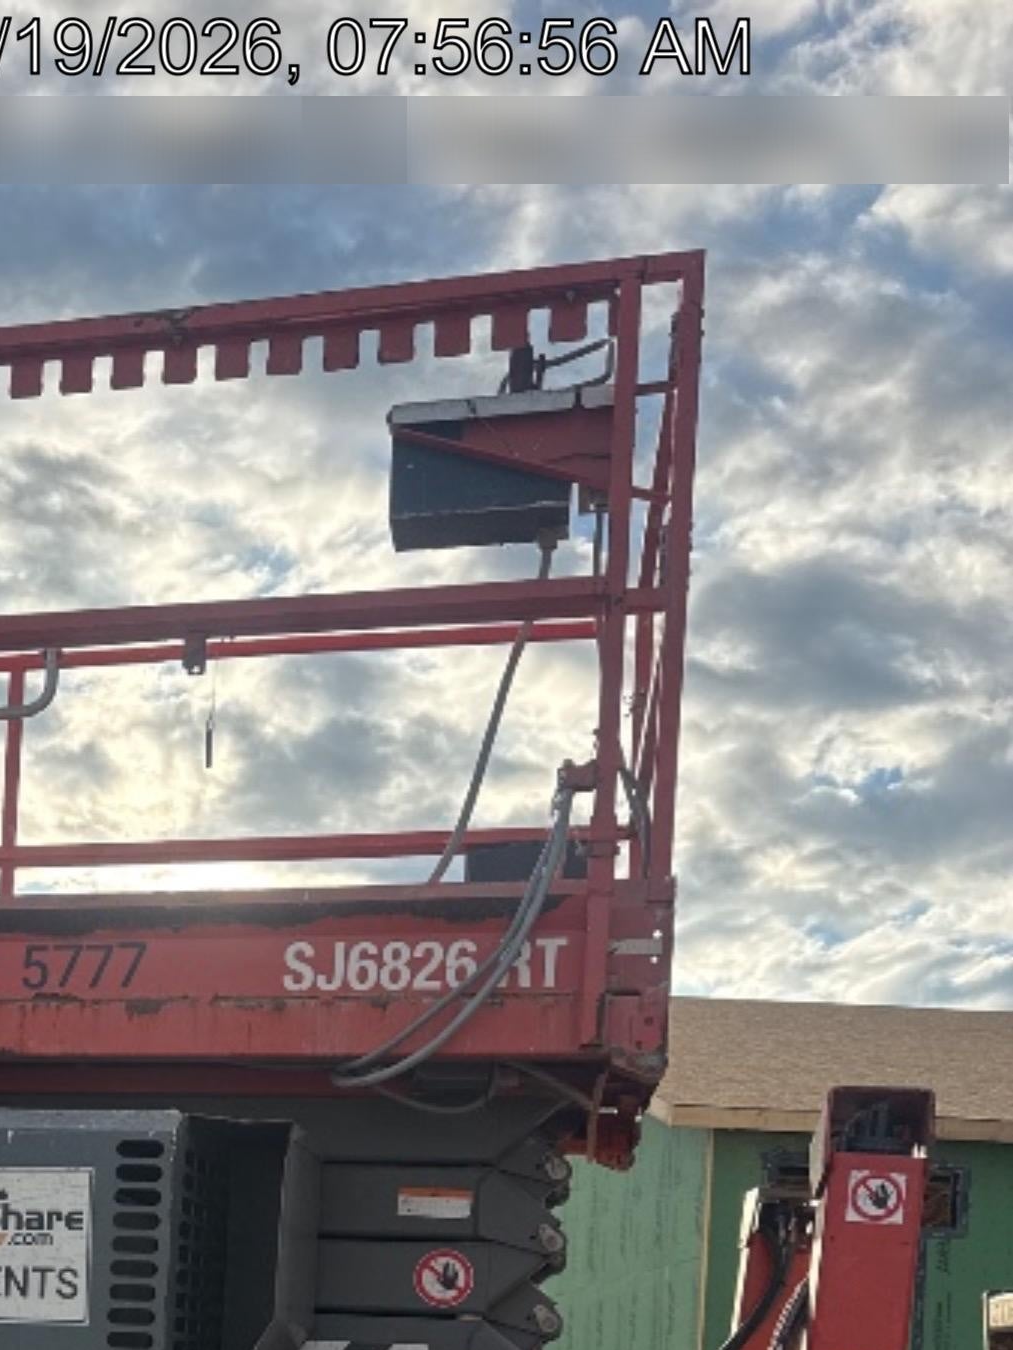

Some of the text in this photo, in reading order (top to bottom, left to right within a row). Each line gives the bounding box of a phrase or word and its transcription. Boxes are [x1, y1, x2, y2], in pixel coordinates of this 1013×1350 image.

[22, 942, 147, 990] 5777
[283, 938, 478, 992] SJ6826
[8, 1231, 54, 1246] .com
